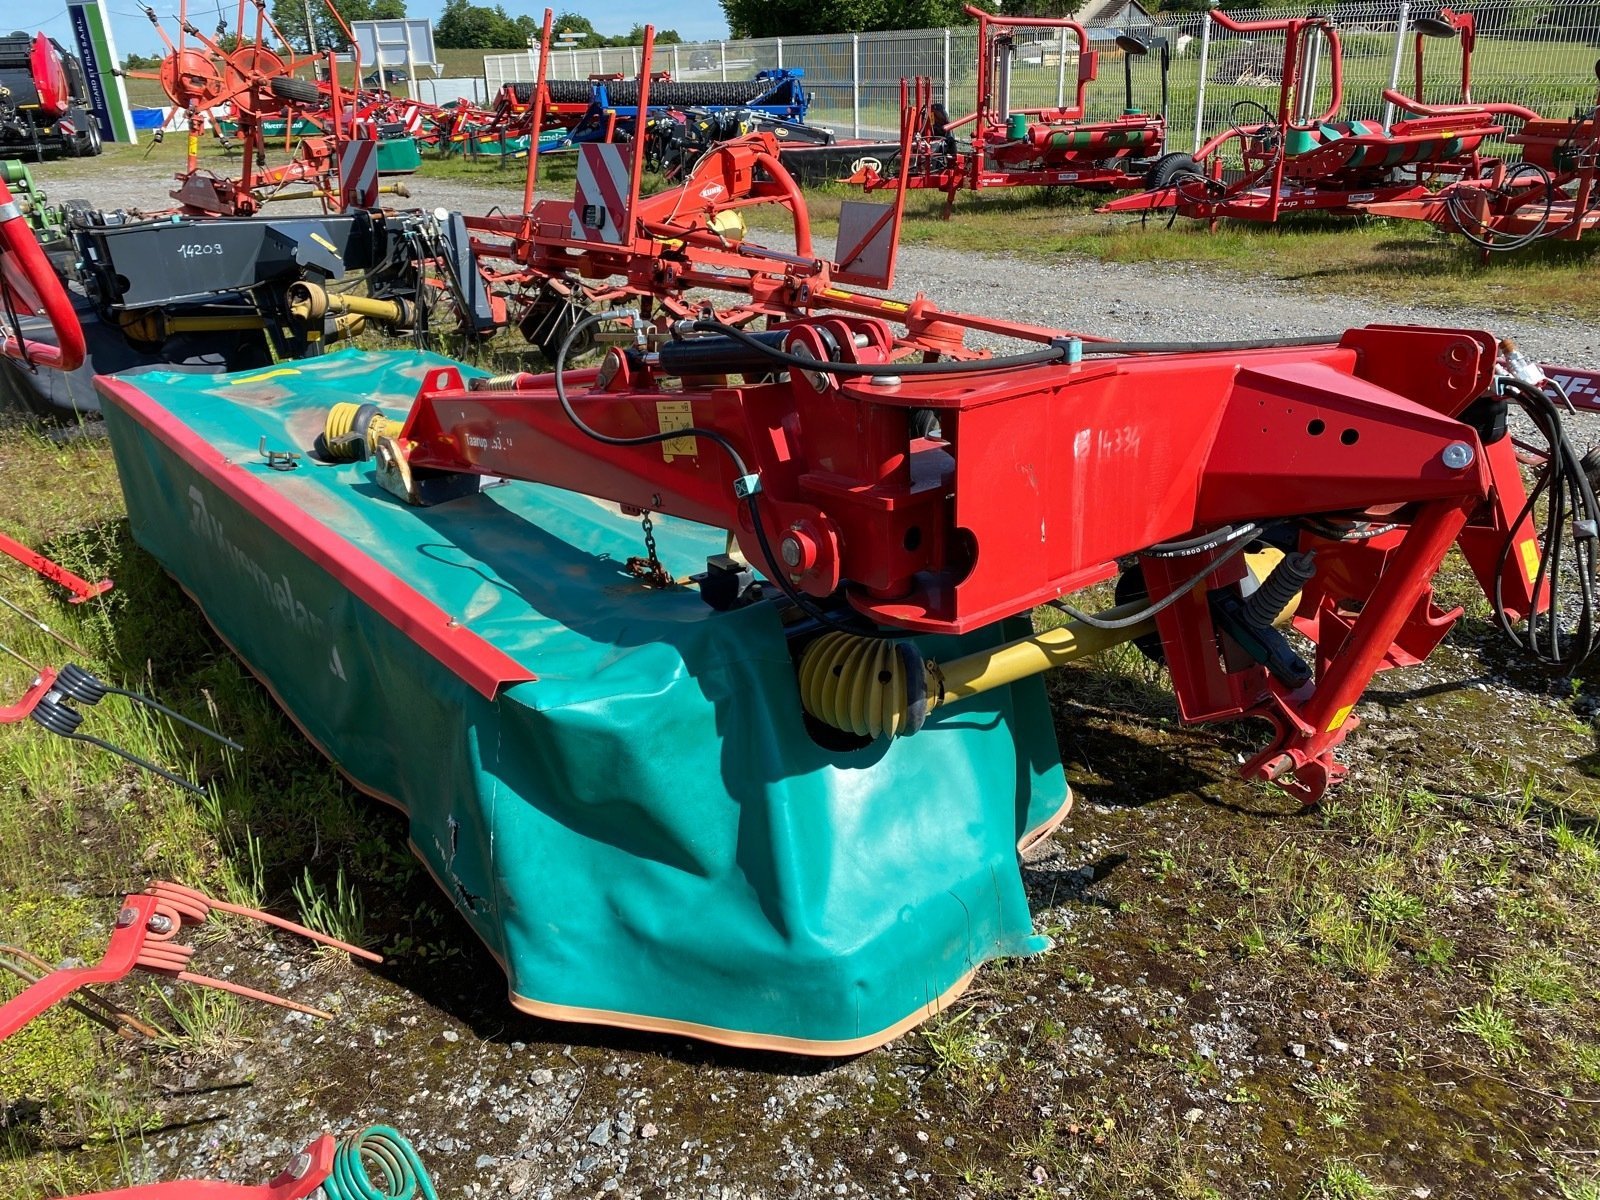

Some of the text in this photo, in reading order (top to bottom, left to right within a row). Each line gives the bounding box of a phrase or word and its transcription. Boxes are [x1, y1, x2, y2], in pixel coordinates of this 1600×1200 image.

[76, 16, 103, 110] RICARD ET FILS S.A.R.L.
[177, 243, 223, 259] 14209
[1543, 374, 1600, 404] JF-
[464, 433, 488, 451] Taarup
[1181, 547, 1201, 557] 5800
[1203, 541, 1219, 551] PSI
